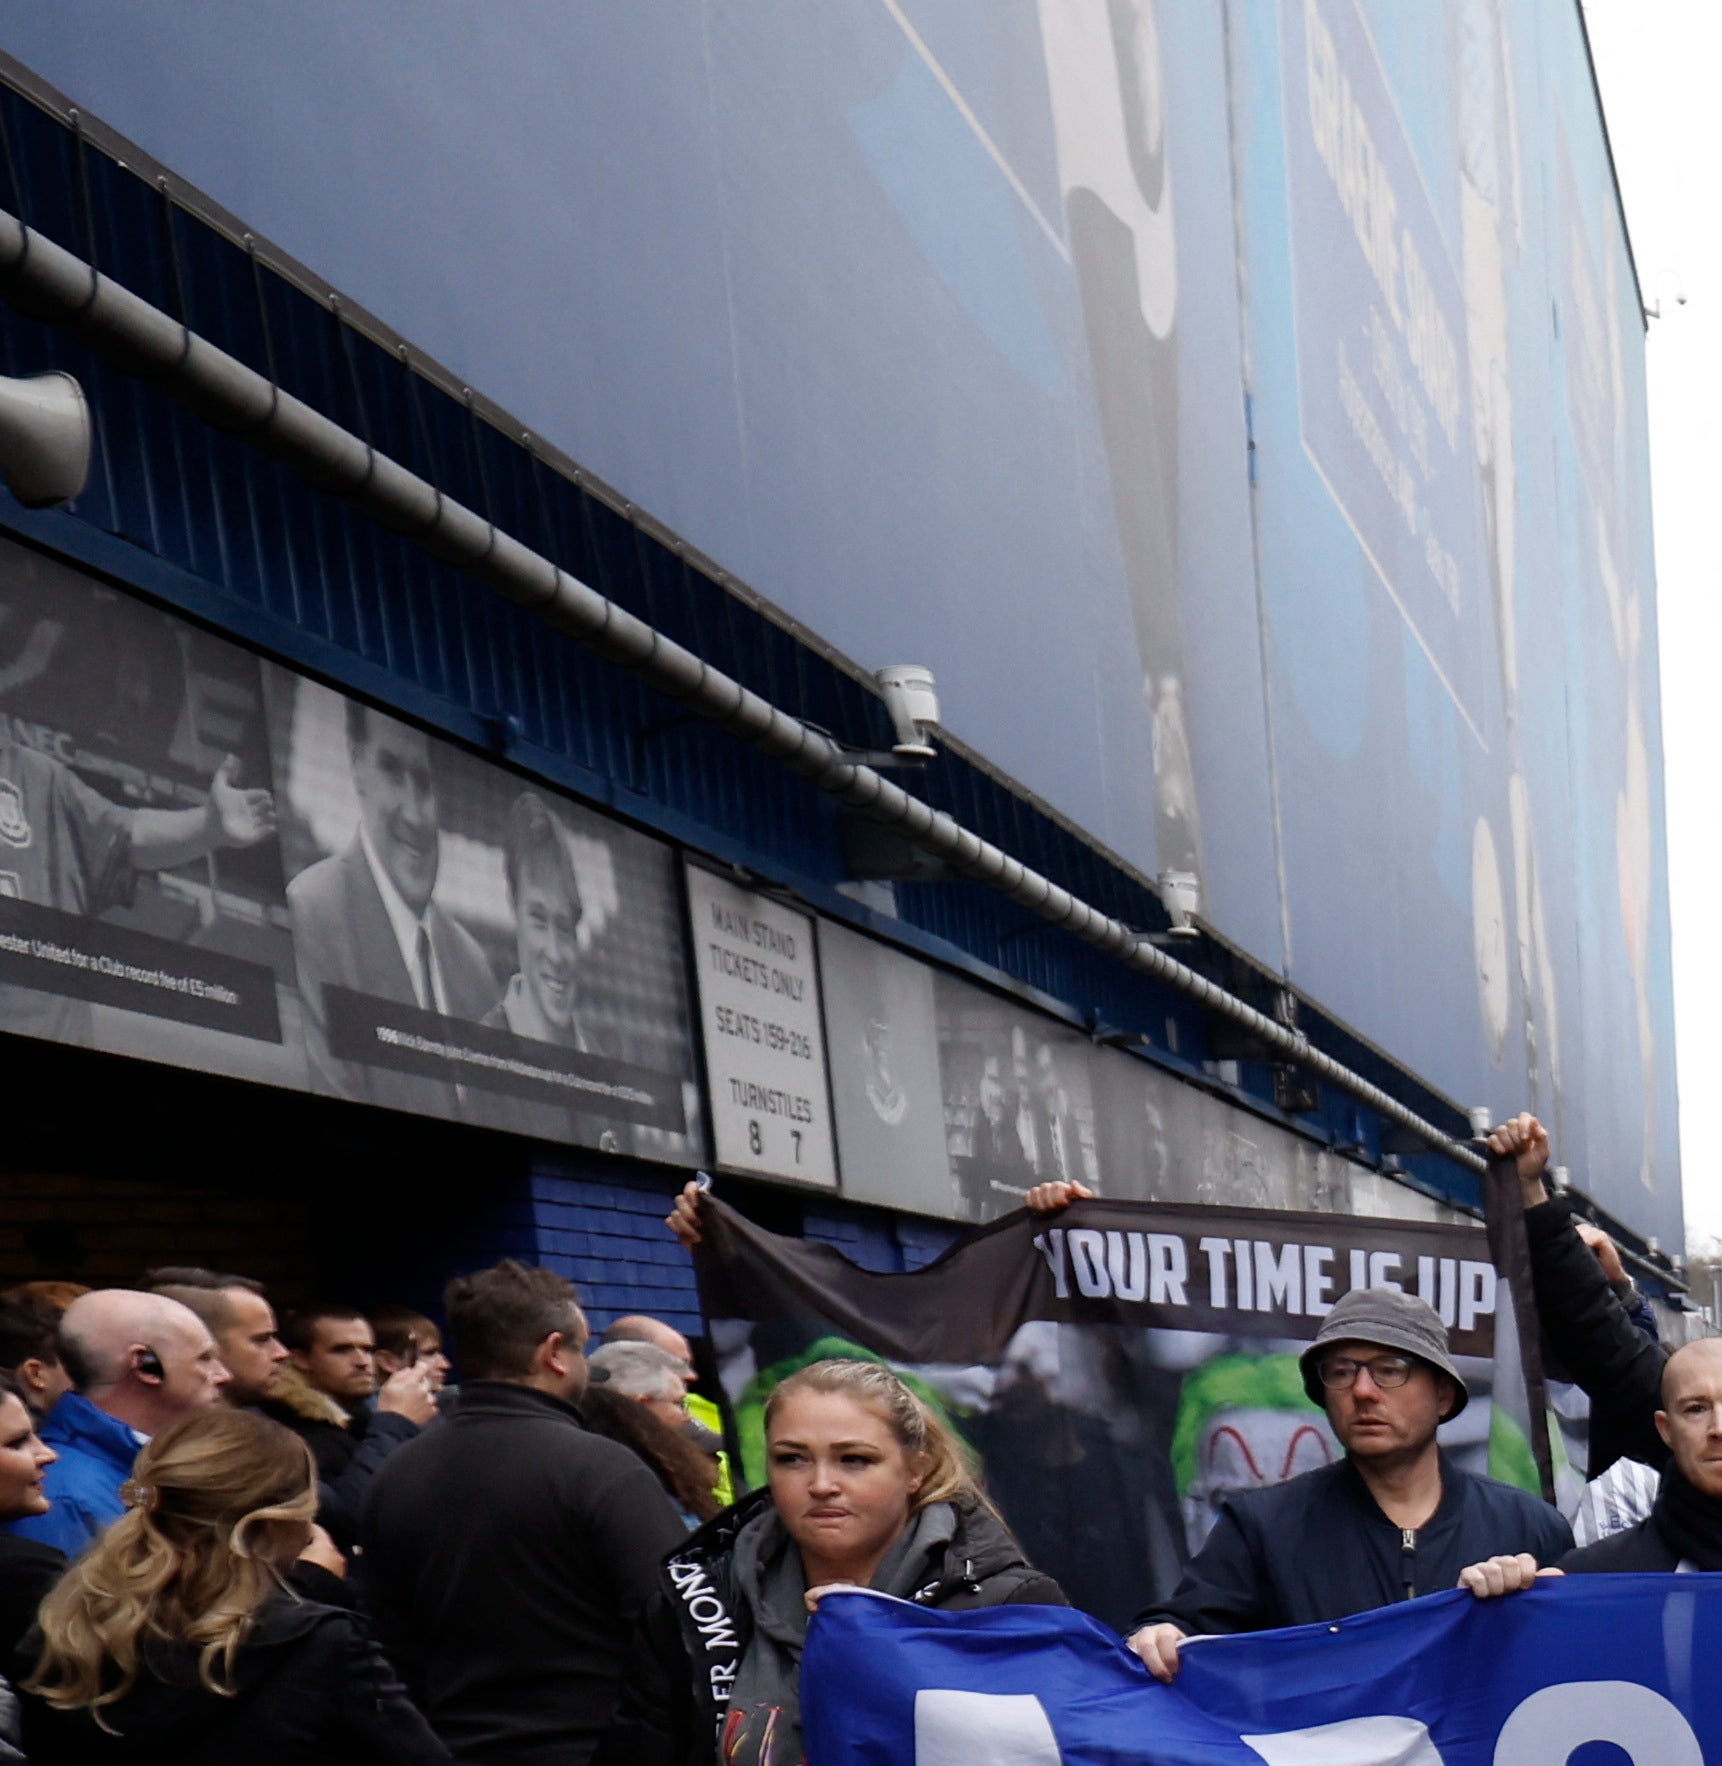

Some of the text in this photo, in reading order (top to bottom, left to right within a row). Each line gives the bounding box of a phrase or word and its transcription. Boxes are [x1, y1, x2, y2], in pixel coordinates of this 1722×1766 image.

[711, 903, 796, 961] MAIN STAND
[708, 943, 803, 1002] TICKETS ONLY
[715, 1006, 812, 1060] SEATS 159-216
[729, 1077, 813, 1124] TURNSTILES
[749, 1119, 802, 1164] 8 7
[1033, 1229, 1188, 1306] YOUR
[1200, 1237, 1335, 1316] TIME
[1417, 1255, 1498, 1331] UP
